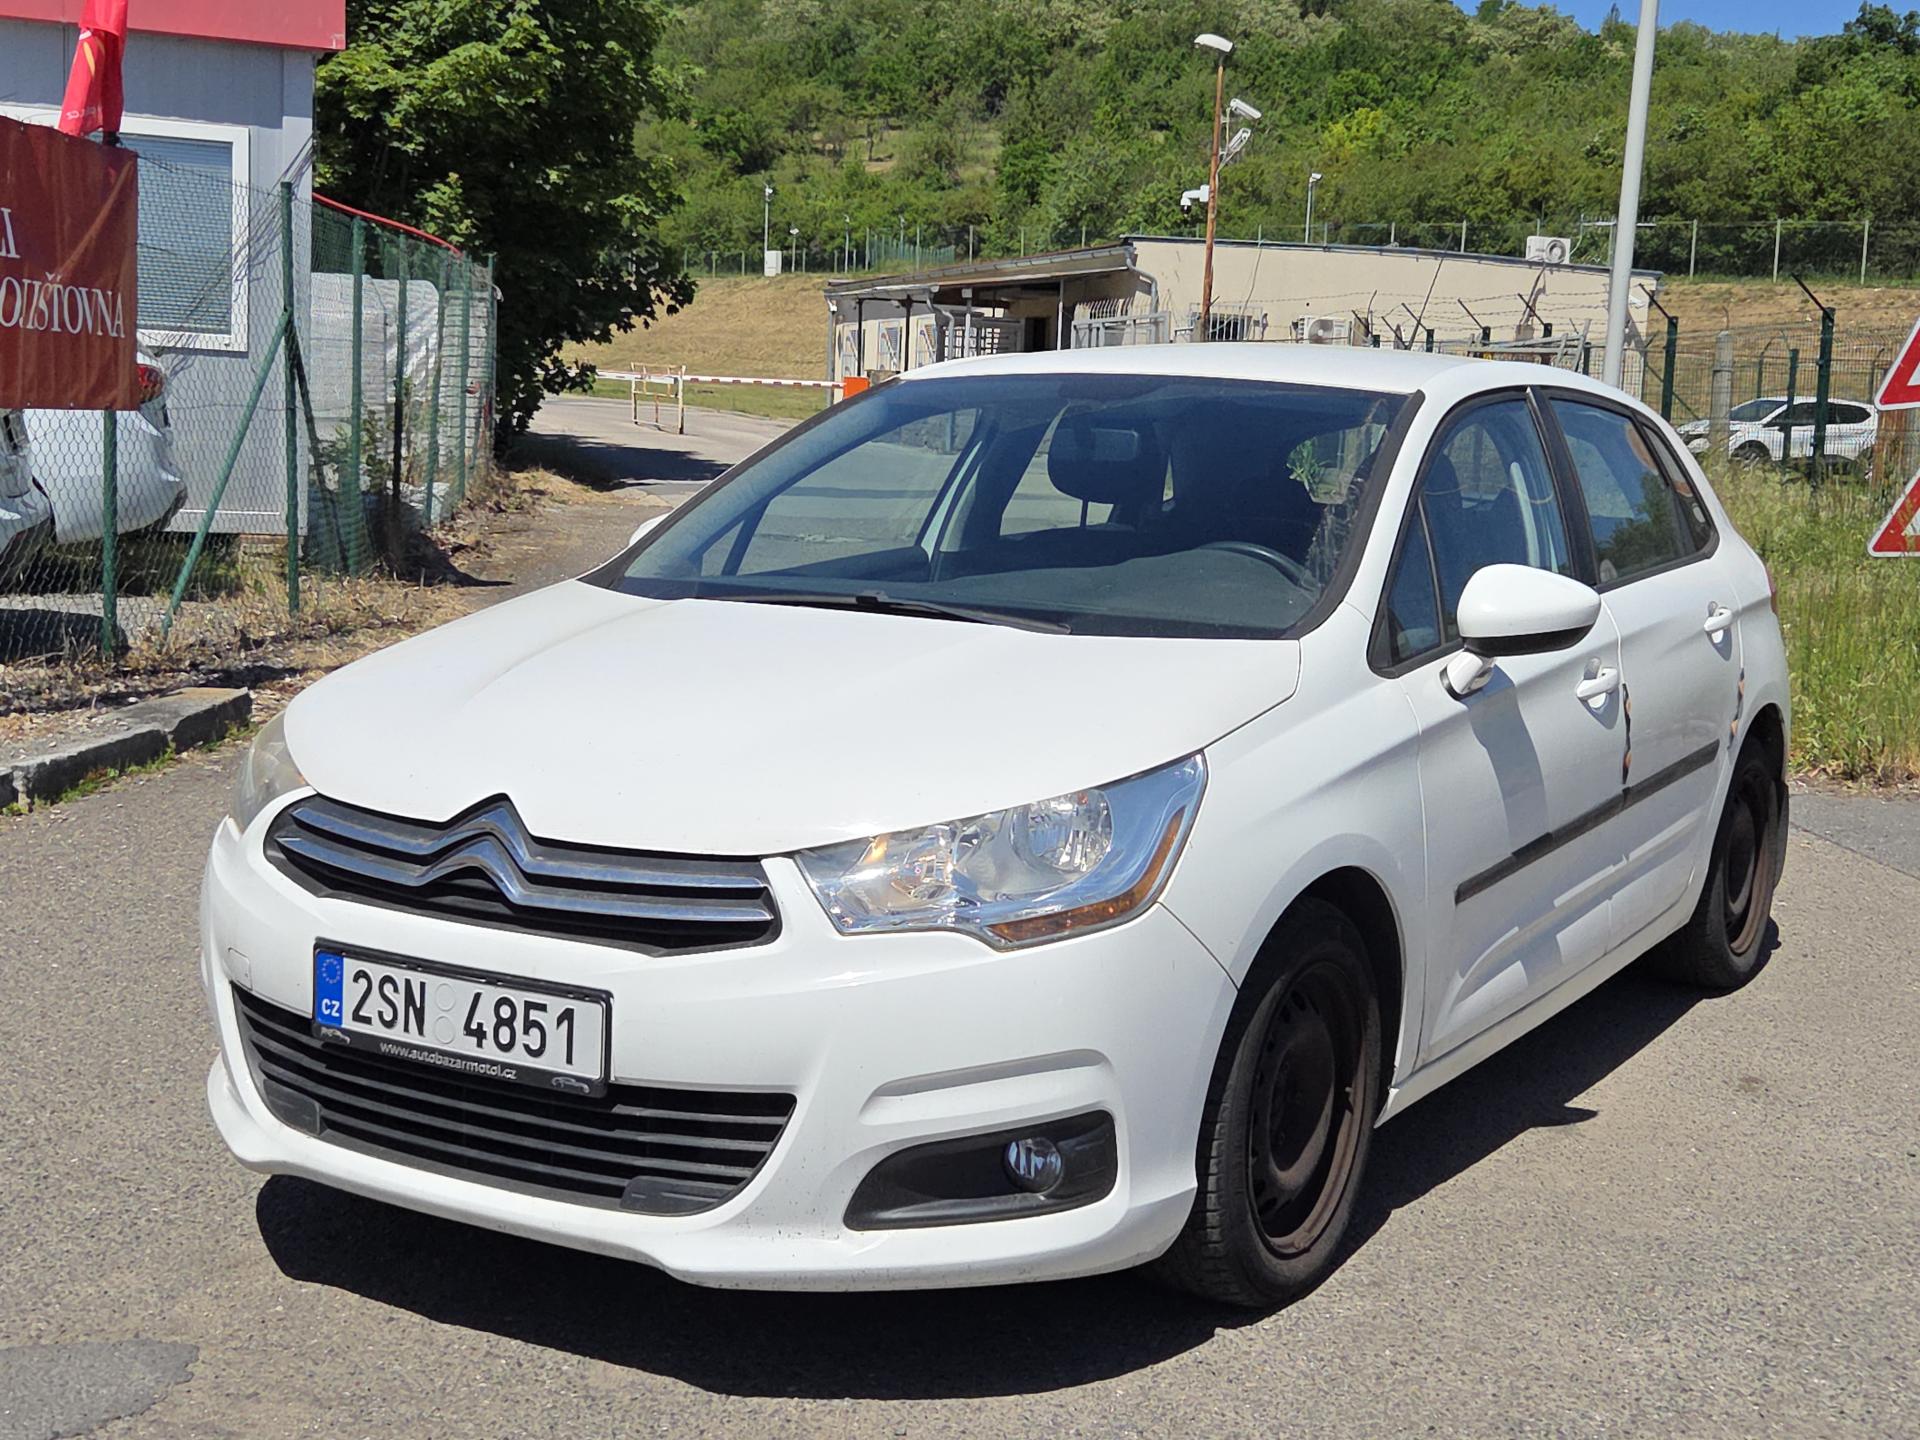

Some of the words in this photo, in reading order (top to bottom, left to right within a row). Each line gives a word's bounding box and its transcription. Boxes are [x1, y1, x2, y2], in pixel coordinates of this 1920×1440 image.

[321, 998, 340, 1018] CZ
[351, 969, 426, 1038] 2SN
[463, 991, 575, 1066] 4851
[379, 1041, 518, 1080] www.autobazarmotol.cz
